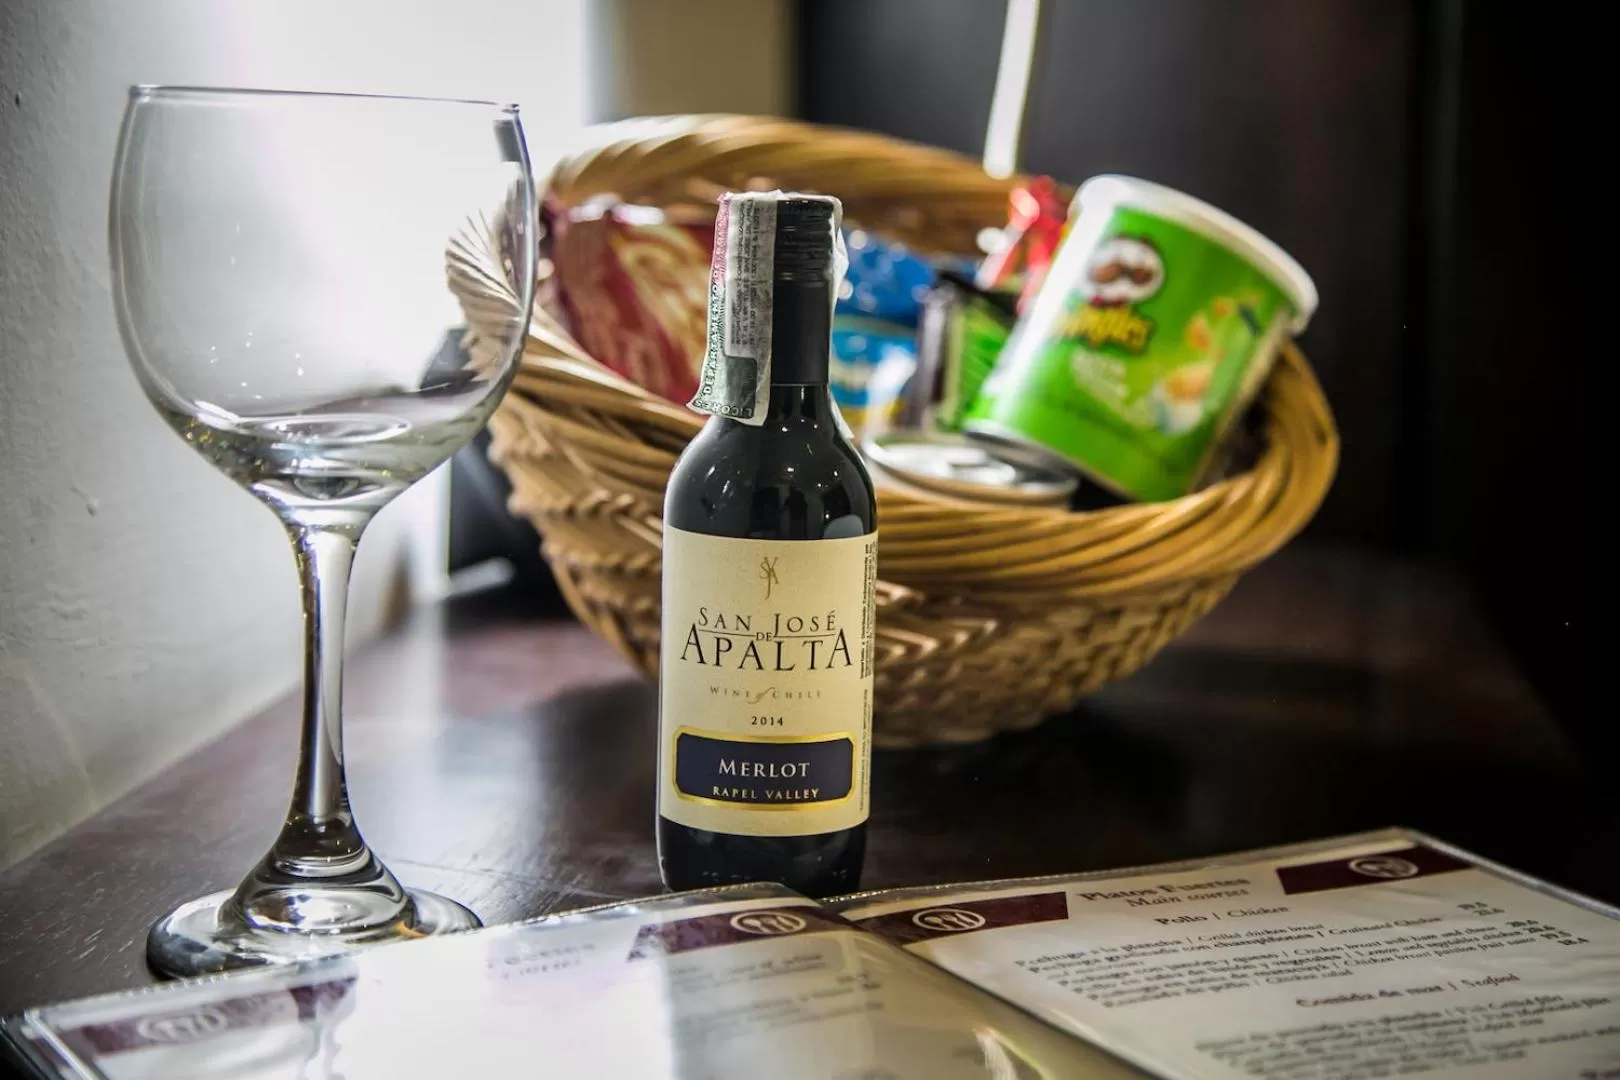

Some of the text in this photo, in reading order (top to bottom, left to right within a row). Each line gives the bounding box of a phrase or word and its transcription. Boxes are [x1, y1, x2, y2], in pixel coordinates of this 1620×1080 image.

[703, 284, 720, 396] DEPARTAMENTO
[694, 400, 753, 417] LICORES
[698, 607, 837, 638] SAN JOSÉ
[755, 631, 774, 642] DE
[680, 623, 853, 672] APALTA
[710, 685, 751, 698] WINE
[751, 716, 784, 726] 2014
[718, 758, 810, 778] MERLOT
[712, 785, 820, 800] RAPEL VALLEY
[1126, 895, 1182, 908] Main
[1154, 914, 1208, 926] Pollo
[1226, 904, 1290, 918] Chicken
